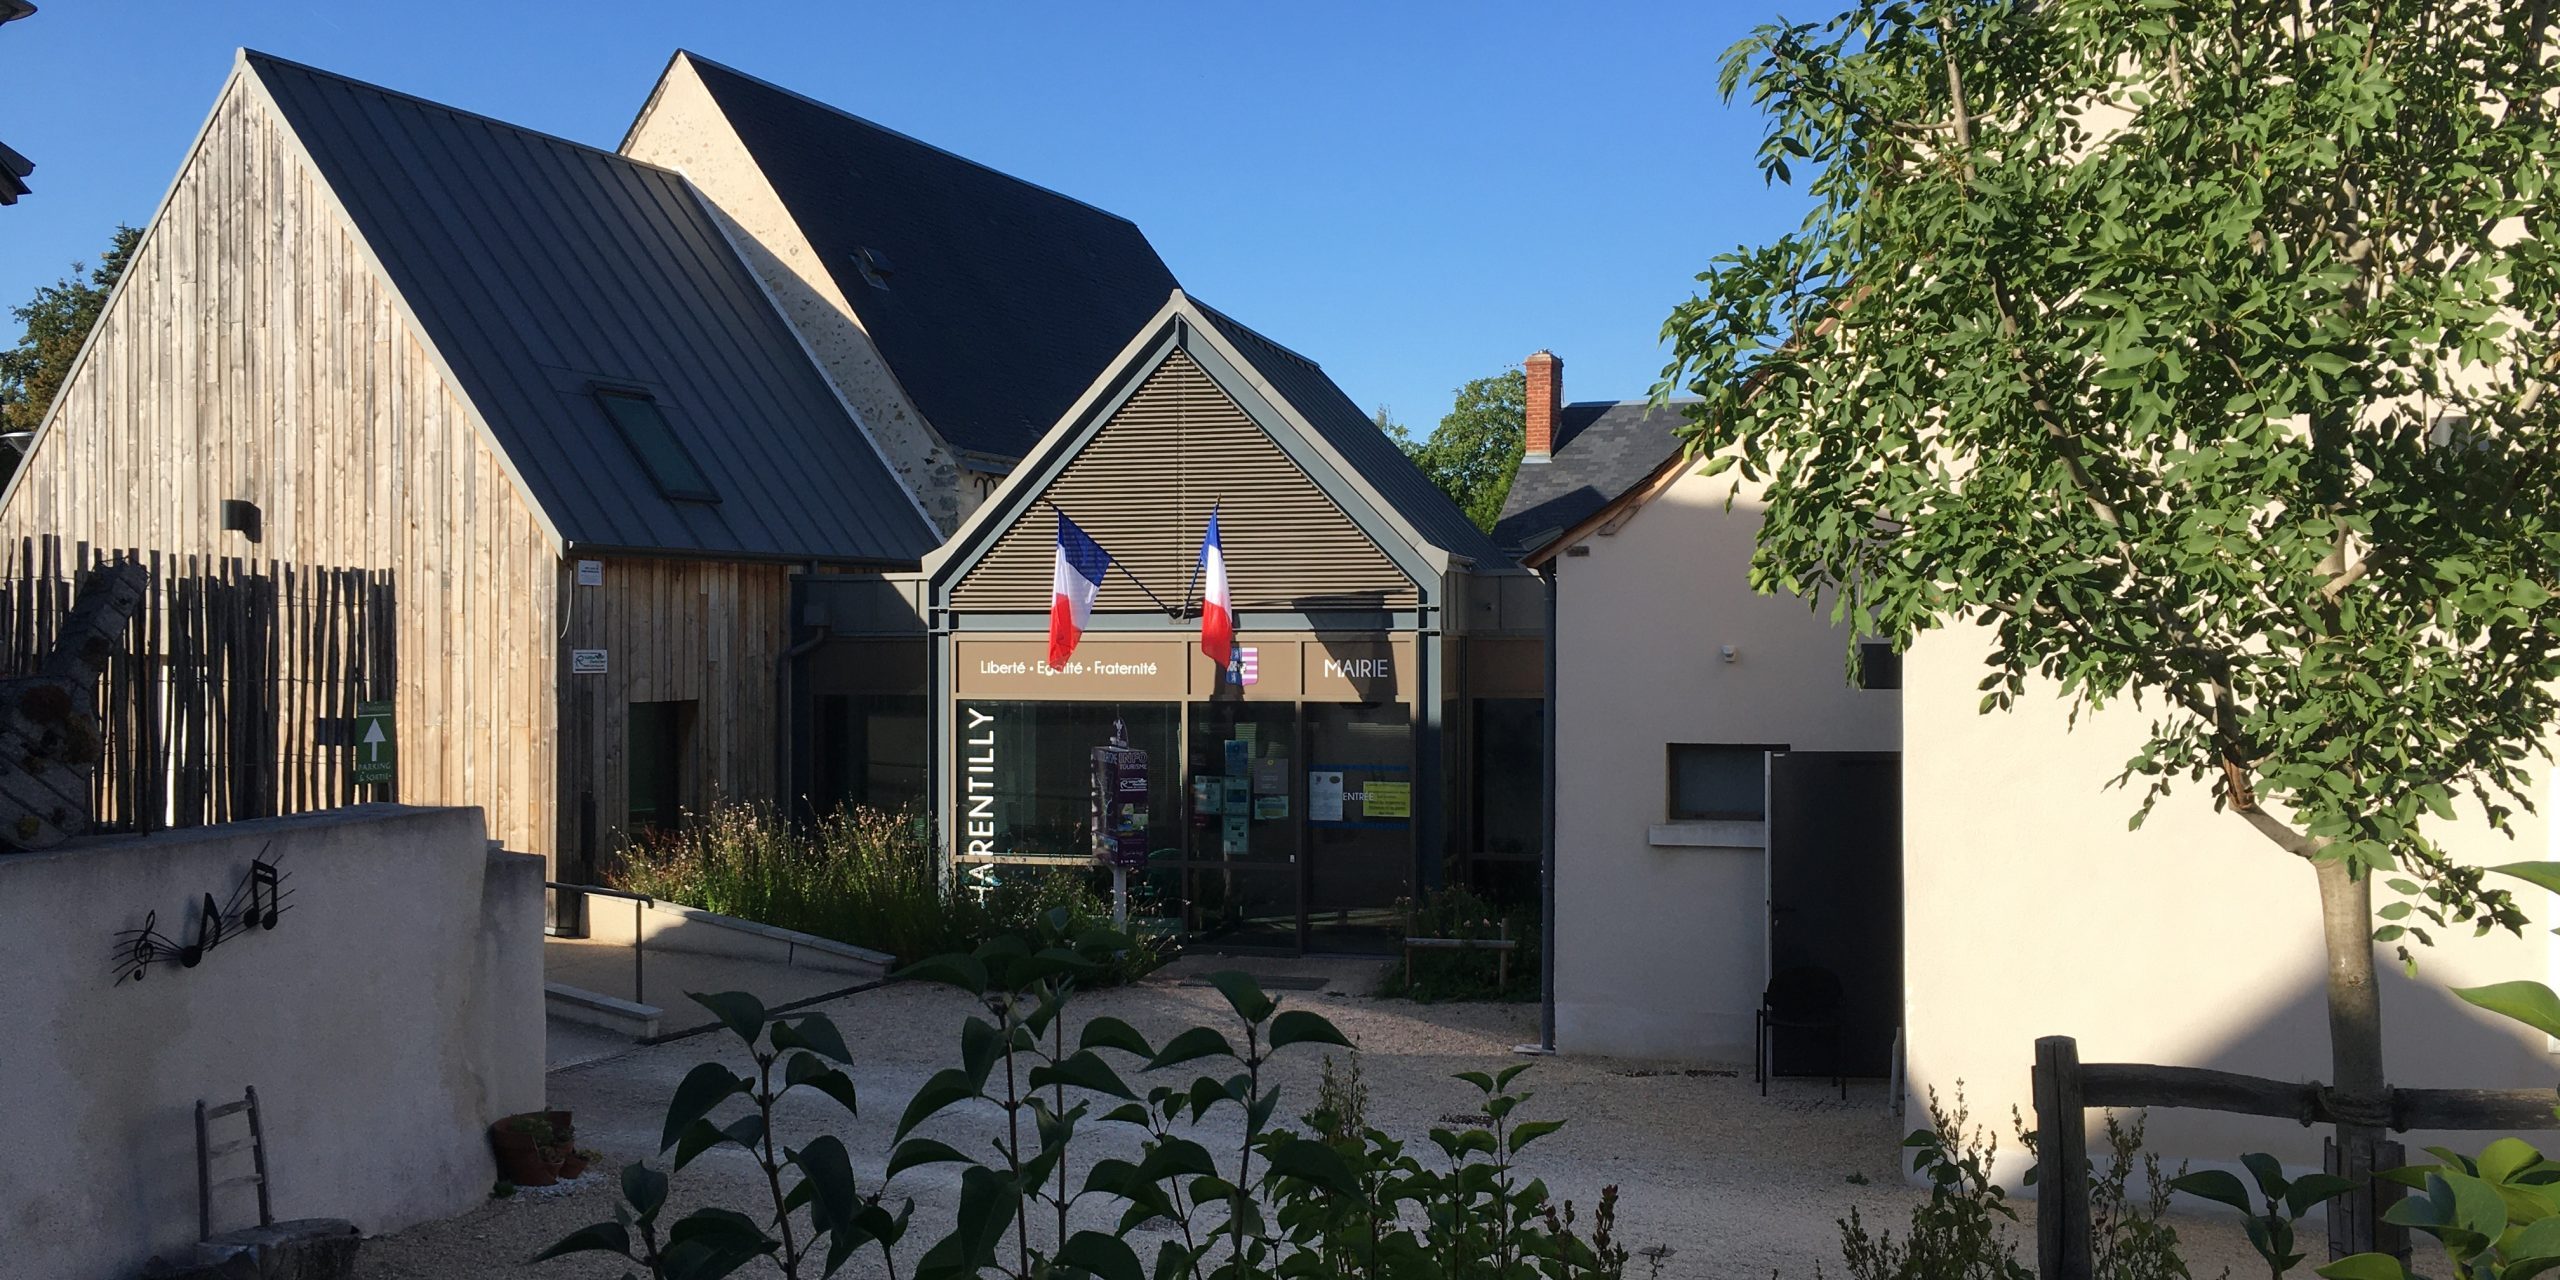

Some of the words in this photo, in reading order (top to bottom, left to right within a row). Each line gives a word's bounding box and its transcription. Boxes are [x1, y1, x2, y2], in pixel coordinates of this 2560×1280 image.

[980, 661, 1026, 674] Liberté
[1094, 661, 1158, 675] Fraternité
[1324, 659, 1388, 678] MAIRIE
[1119, 752, 1148, 763] INFO
[968, 707, 994, 907] HARENTILLY
